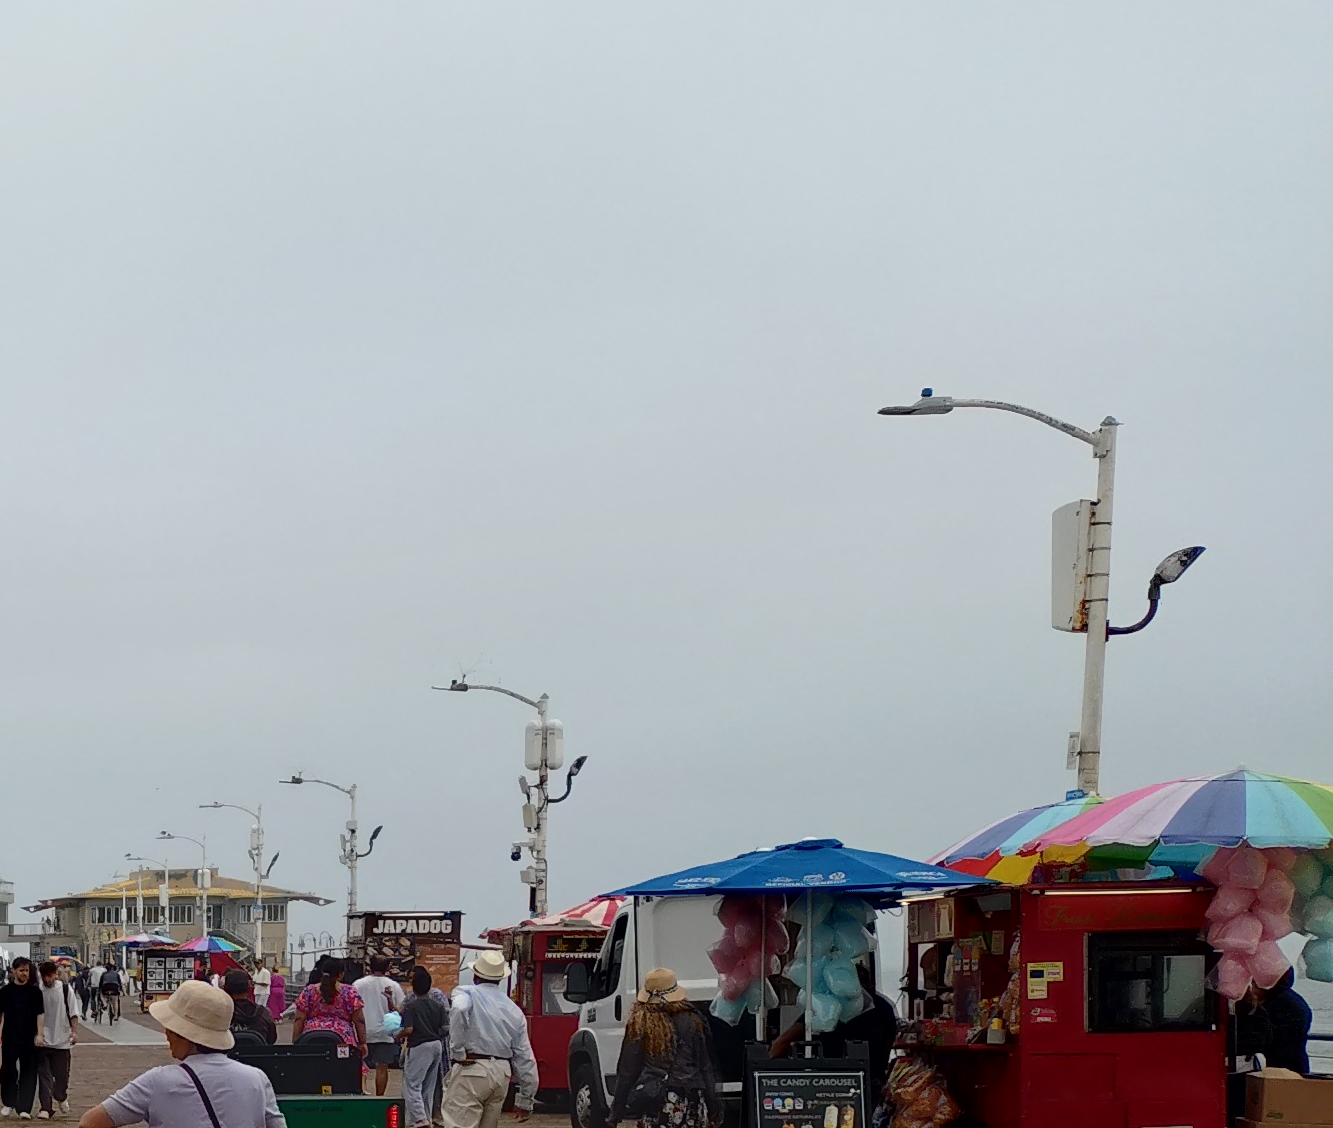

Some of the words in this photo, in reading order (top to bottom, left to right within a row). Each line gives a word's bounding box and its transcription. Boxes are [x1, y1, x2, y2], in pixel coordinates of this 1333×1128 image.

[372, 919, 452, 934] JAPADOG
[761, 1078, 779, 1087] THE
[780, 1078, 810, 1087] CANDY
[812, 1078, 858, 1087] CAROUSEL
